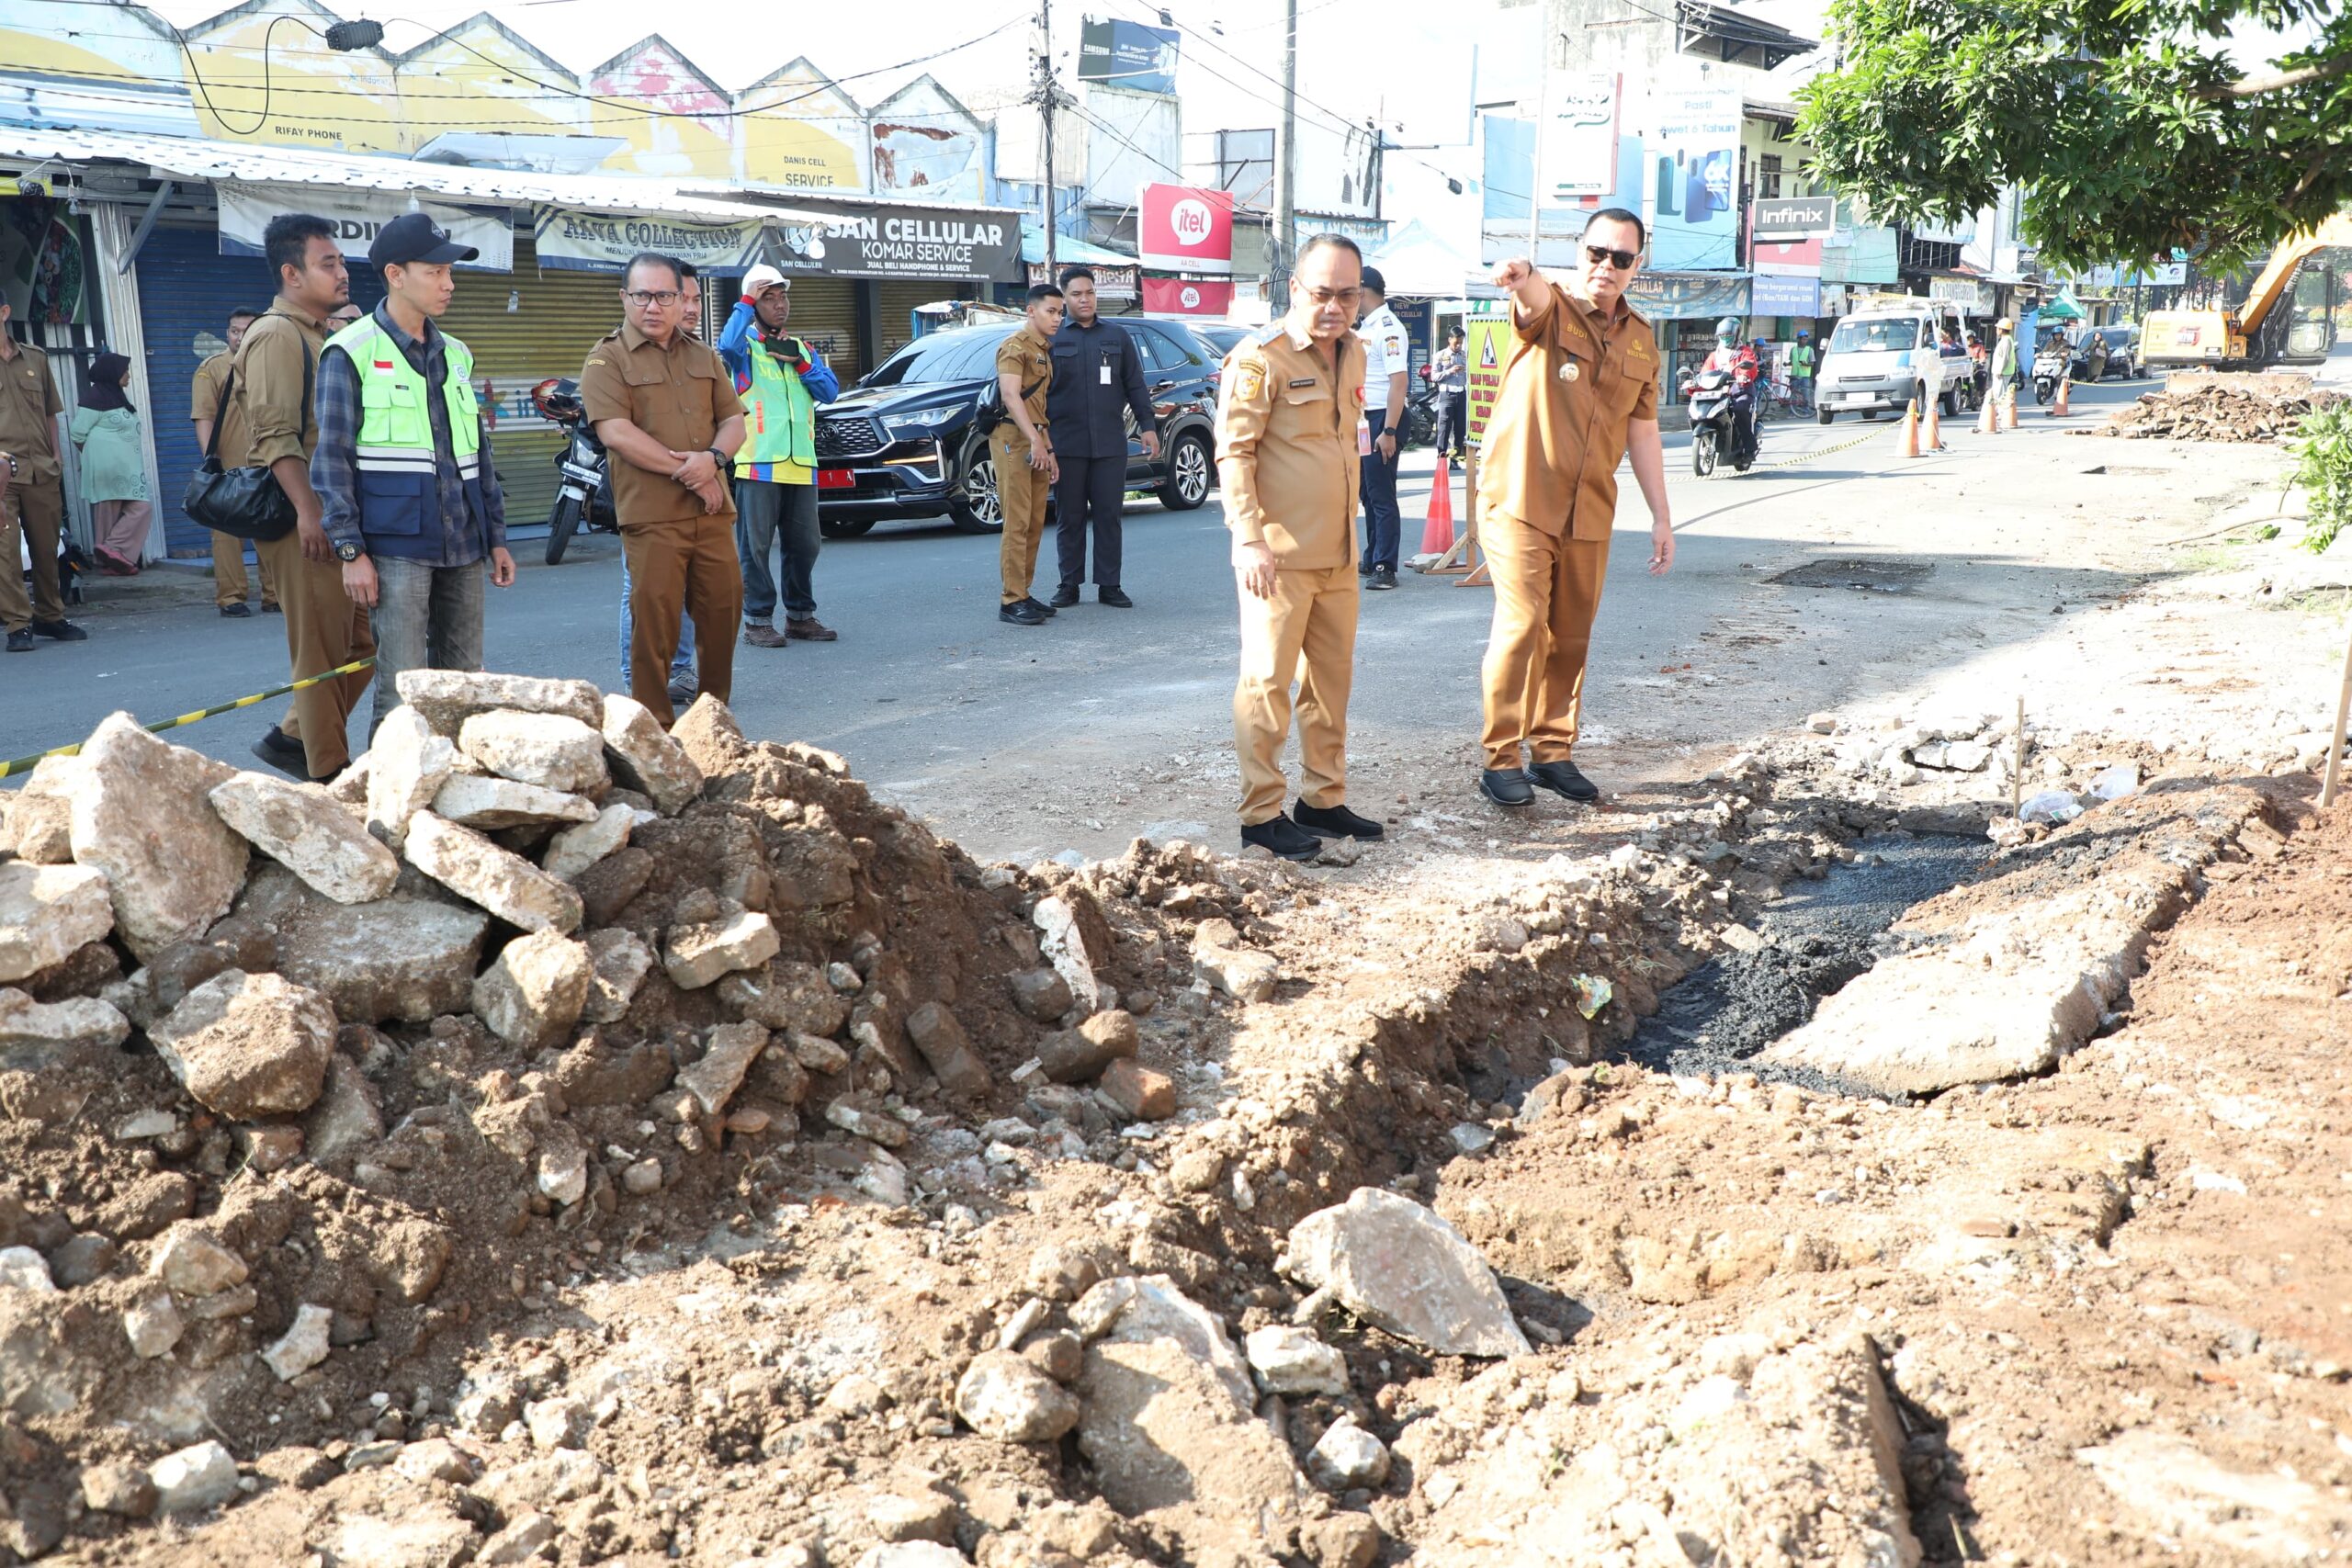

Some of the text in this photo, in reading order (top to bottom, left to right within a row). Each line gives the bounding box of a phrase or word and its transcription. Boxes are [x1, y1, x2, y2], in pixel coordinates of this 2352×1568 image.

[275, 125, 343, 141] RIFAY PHONE
[1702, 124, 1736, 133] Tahun
[784, 155, 827, 167] DANIS CELL
[786, 173, 834, 187] SERVICE
[1179, 208, 1204, 233] itel
[1761, 208, 1824, 224] Infinix
[625, 222, 742, 249] COLLECTION
[885, 220, 1003, 247] CELLULAR
[861, 241, 972, 263] KOMAR SERVICE
[866, 261, 883, 269] JUAL
[884, 262, 899, 270] BELI
[899, 263, 937, 271] HANDPHONE
[944, 264, 970, 273] SERVICE
[1394, 302, 1409, 310] NEW
[1566, 323, 1588, 339] BUDI
